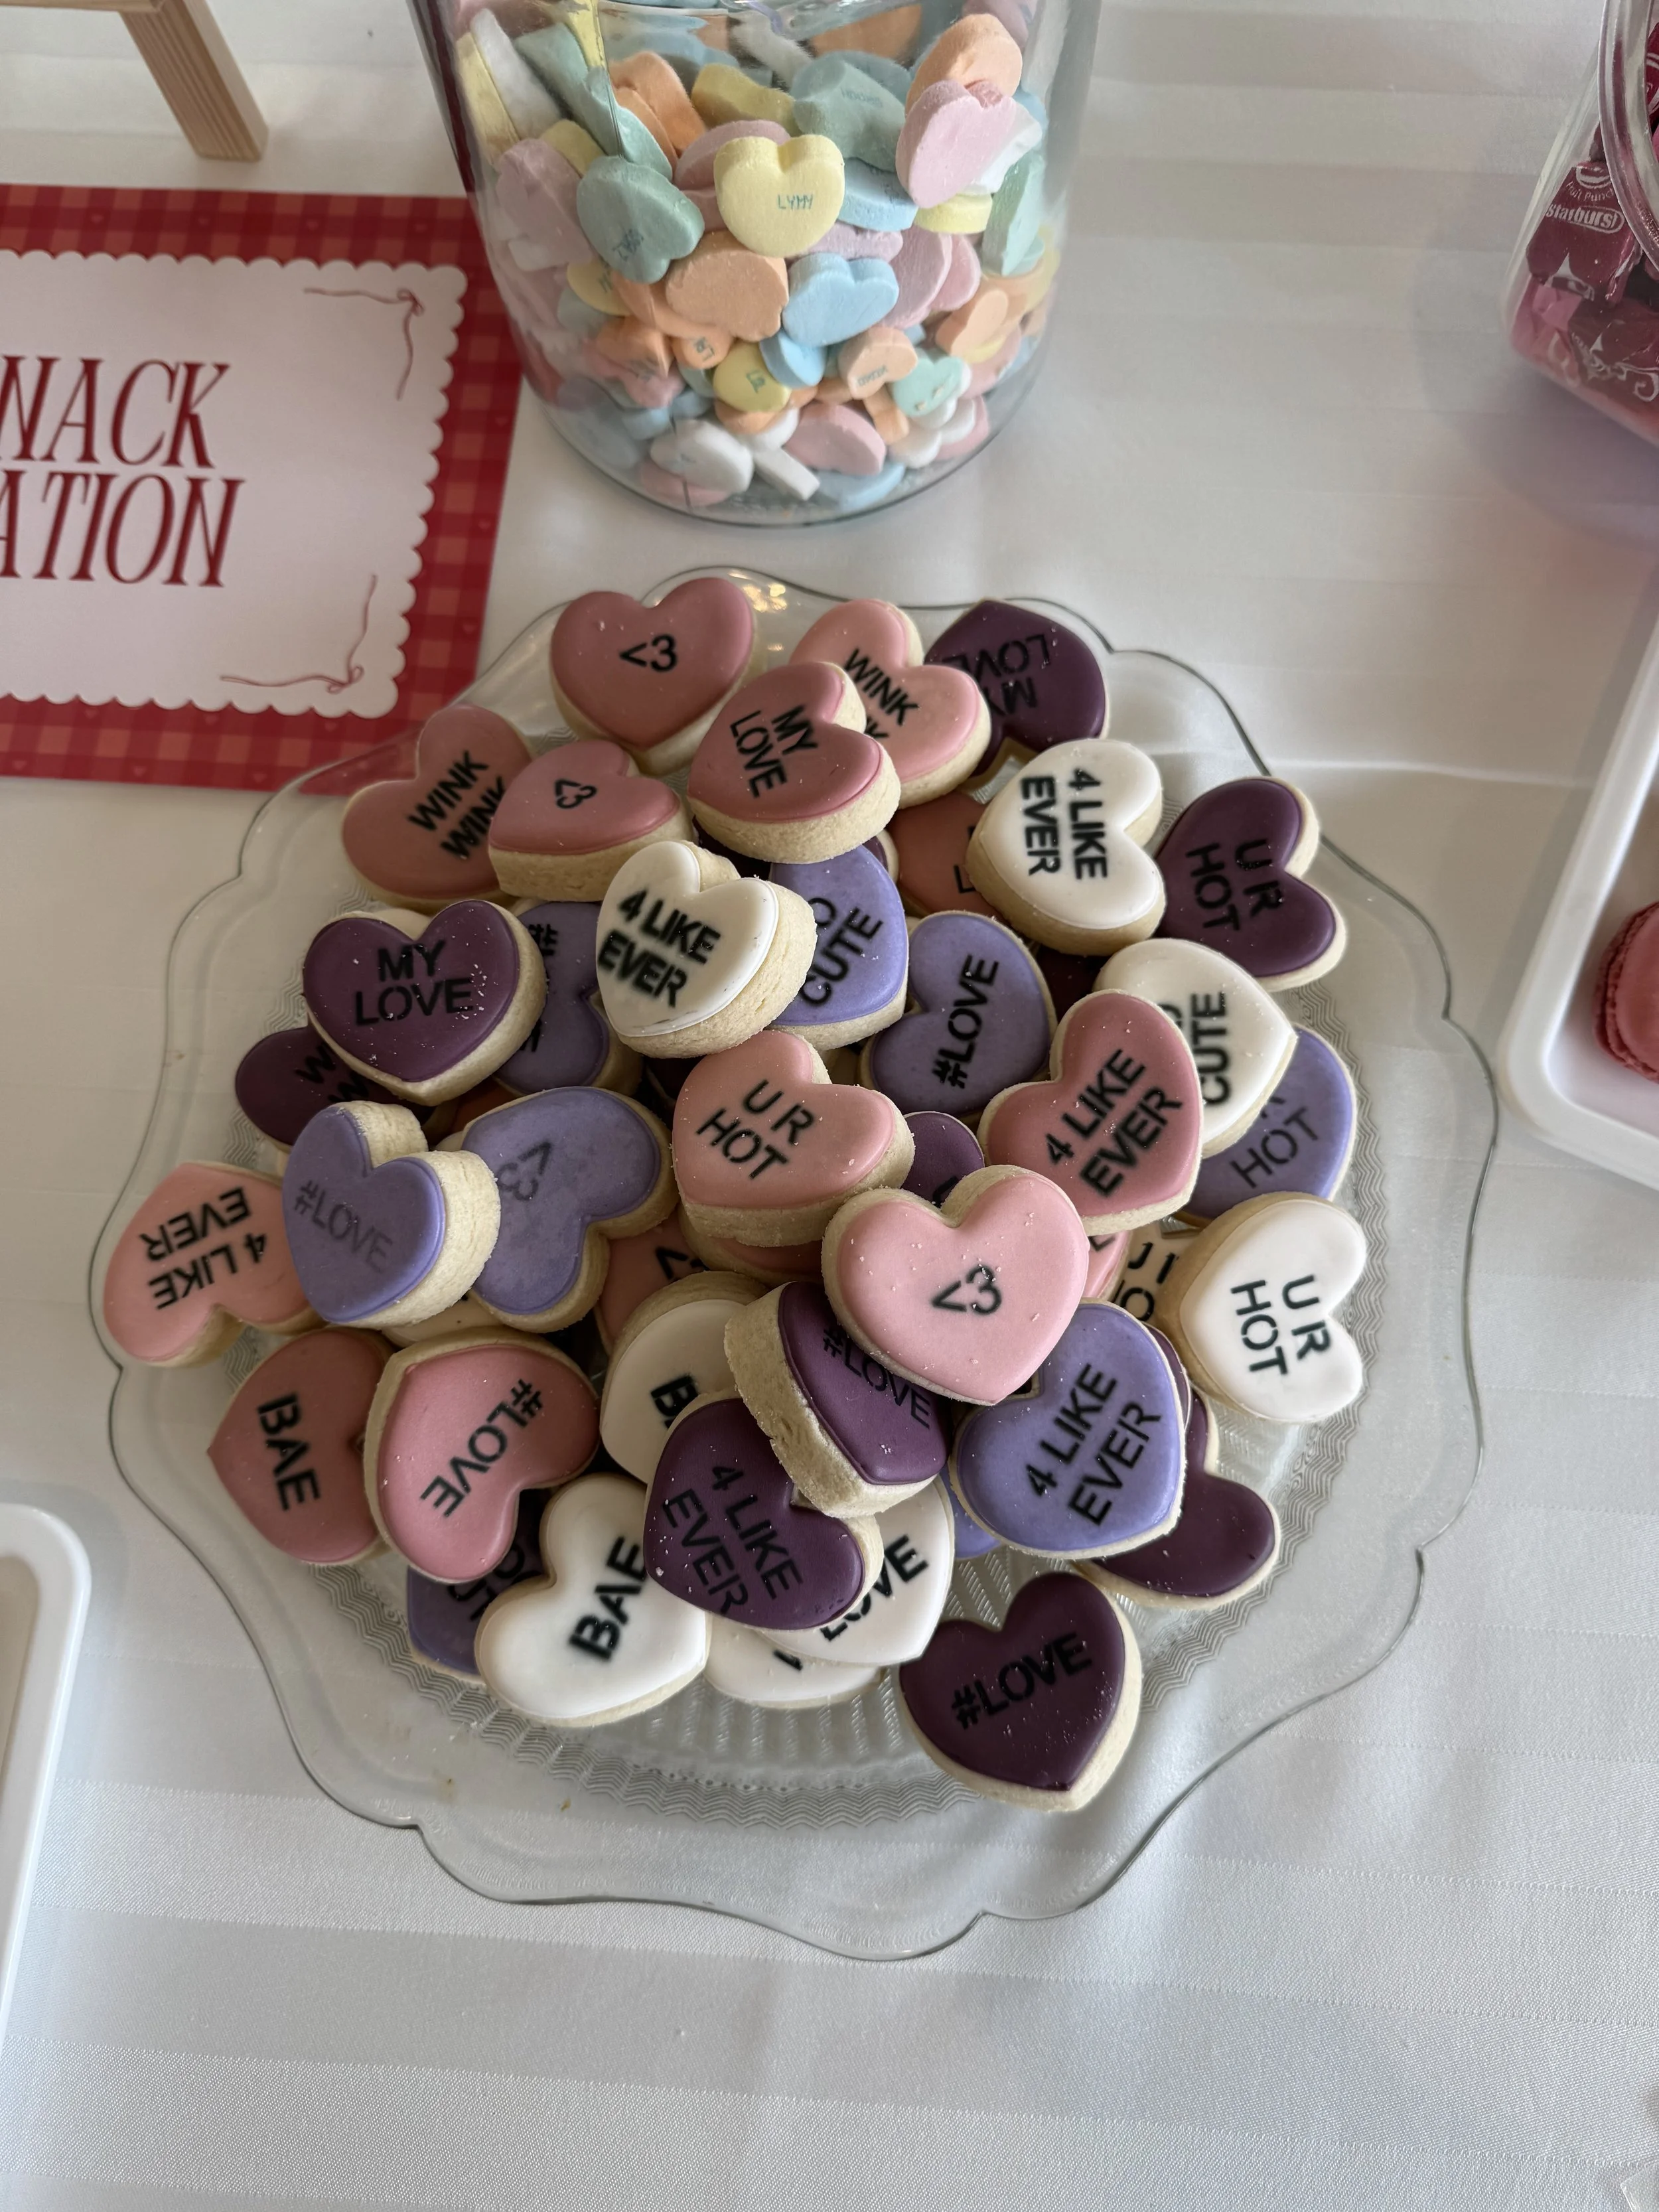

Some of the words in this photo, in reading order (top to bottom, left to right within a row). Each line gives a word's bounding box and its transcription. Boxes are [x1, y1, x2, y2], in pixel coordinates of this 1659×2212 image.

[1546, 203, 1618, 229] Starburst
[0, 355, 230, 469] NACK
[618, 634, 678, 672] <3
[842, 648, 920, 726] WINK
[731, 710, 787, 798] LOVE
[771, 705, 818, 756] MY
[407, 750, 490, 832] WINK
[440, 775, 506, 859] WINK
[554, 779, 597, 809] <3
[1068, 767, 1101, 792] 4
[1021, 776, 1062, 876] EVER
[1068, 800, 1108, 880] LIKE
[1234, 839, 1267, 871] U
[1186, 842, 1240, 931] HOT
[1243, 881, 1285, 917] R
[378, 940, 446, 982] MY
[618, 890, 648, 923] 4
[644, 899, 721, 965] LIKE
[800, 907, 884, 1007] CUTE
[355, 977, 474, 1027] LOVE
[598, 929, 687, 1009] EVER
[932, 954, 1000, 1090] #LOVE
[1191, 991, 1230, 1105] CUTE
[696, 1108, 789, 1180] HOT
[743, 1079, 784, 1114] U
[770, 1104, 814, 1145] R
[1045, 1133, 1075, 1165] 4
[1064, 1049, 1145, 1140] LIKE
[1080, 1089, 1183, 1197] EVER
[1232, 1106, 1319, 1189] HOT
[139, 1187, 252, 1262] EVER
[245, 1232, 268, 1264] 4
[295, 1179, 394, 1274] #LOVE
[147, 1246, 240, 1310] LIKE
[932, 1264, 1003, 1315] <3
[1281, 1274, 1321, 1311] U
[1230, 1279, 1289, 1376] HOT
[1291, 1319, 1333, 1361] R
[823, 1328, 930, 1430] #LOVE
[1039, 1363, 1118, 1464] LIKE
[257, 1392, 321, 1511] BAE
[419, 1378, 544, 1518] #LOVE
[711, 1464, 744, 1491] 4
[1026, 1463, 1058, 1497] 4
[1066, 1402, 1162, 1527] EVER
[664, 1487, 749, 1615] EVER
[725, 1495, 803, 1601] LIKE
[569, 1535, 648, 1662] BAE
[951, 1631, 1093, 1731] #LOVE
